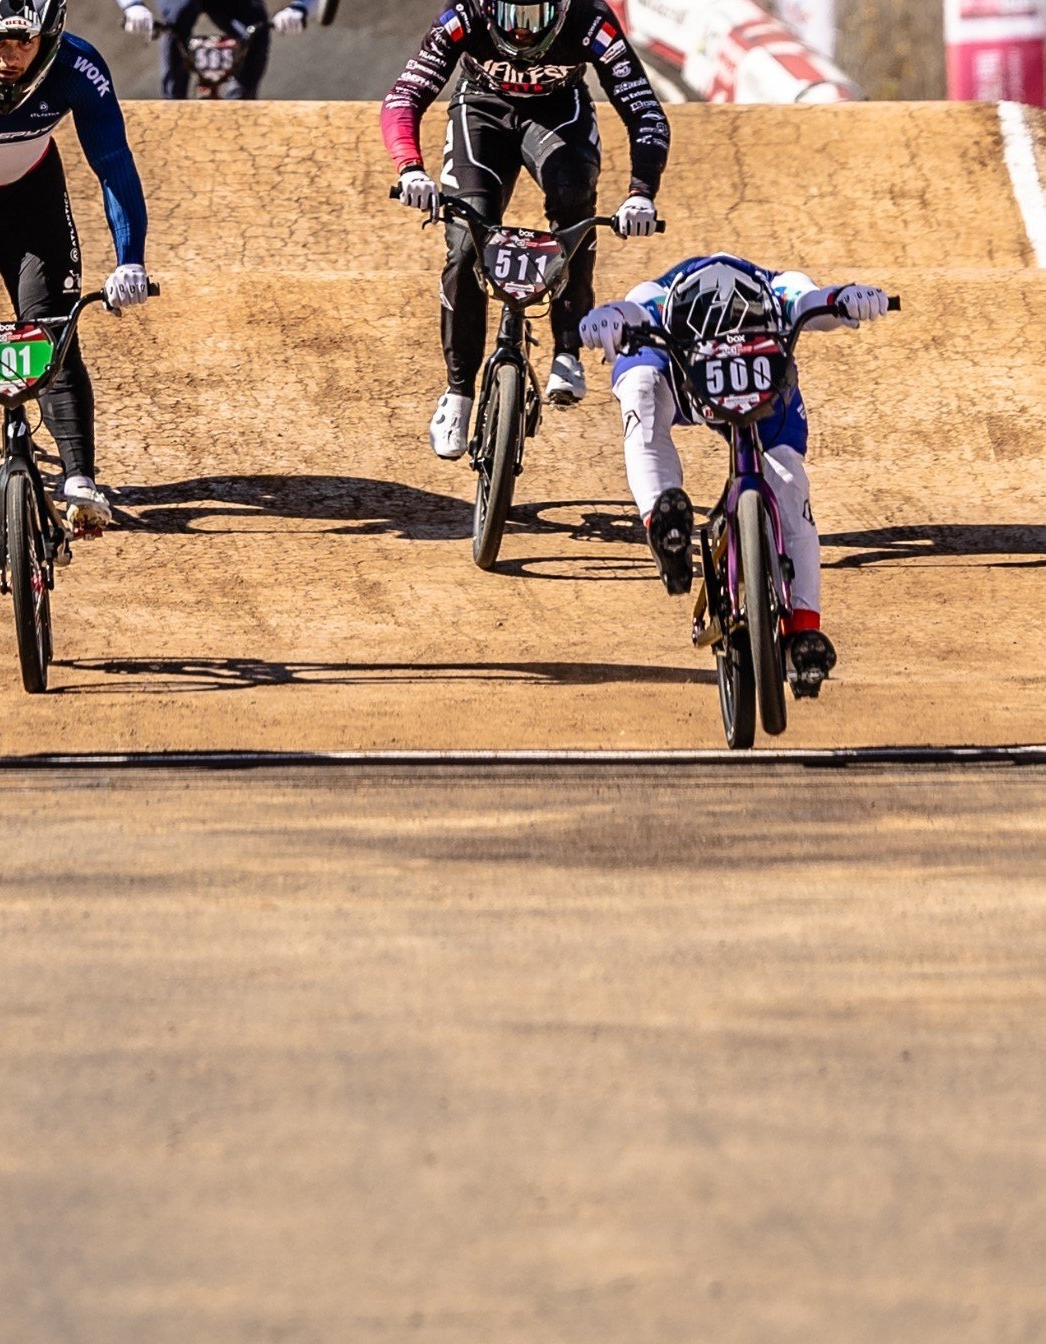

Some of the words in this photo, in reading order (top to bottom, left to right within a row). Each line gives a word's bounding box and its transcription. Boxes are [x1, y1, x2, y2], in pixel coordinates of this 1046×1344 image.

[494, 249, 548, 284] 511
[726, 333, 746, 344] box
[705, 355, 772, 395] 500
